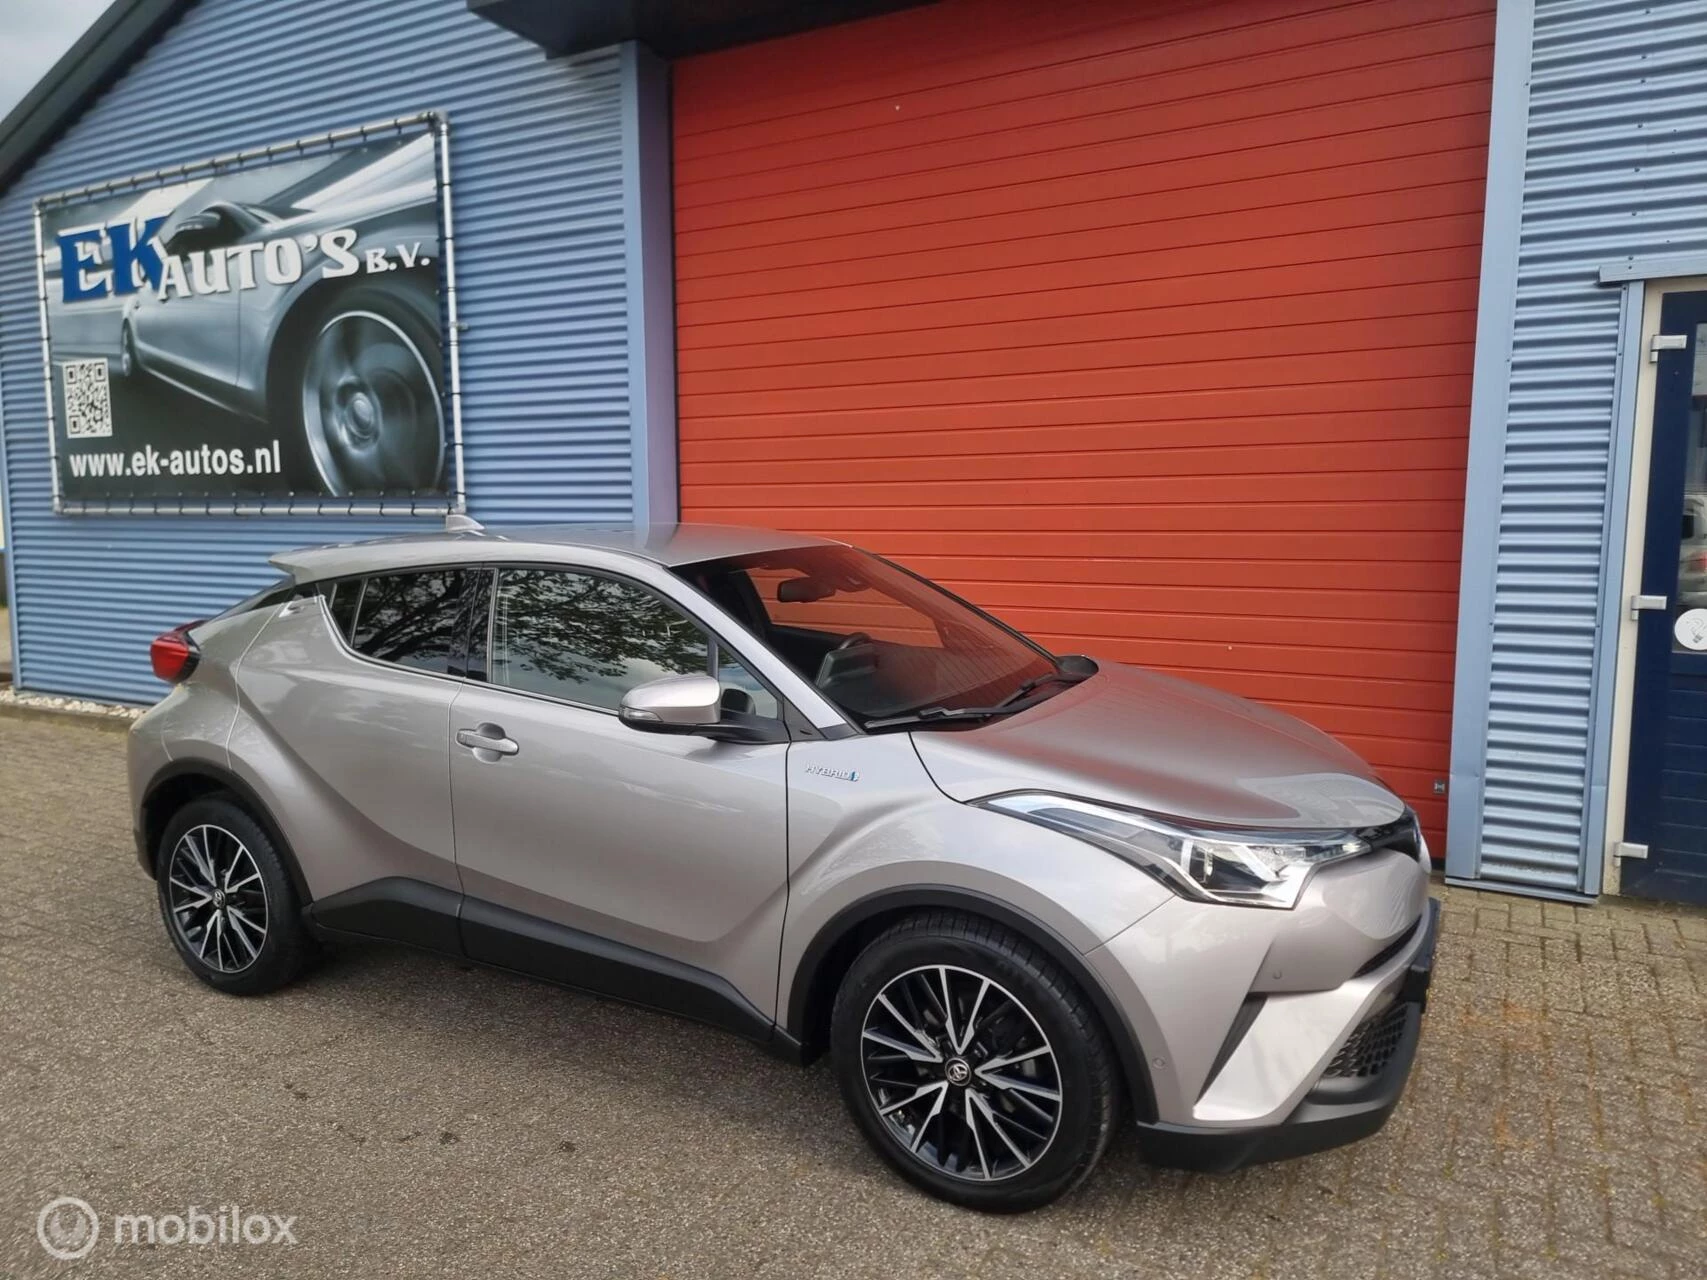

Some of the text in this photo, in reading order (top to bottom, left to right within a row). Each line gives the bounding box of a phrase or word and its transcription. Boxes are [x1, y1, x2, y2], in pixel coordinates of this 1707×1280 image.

[57, 215, 431, 303] EK AUTO'S B.V.
[69, 440, 282, 478] www.ek-autos.nl
